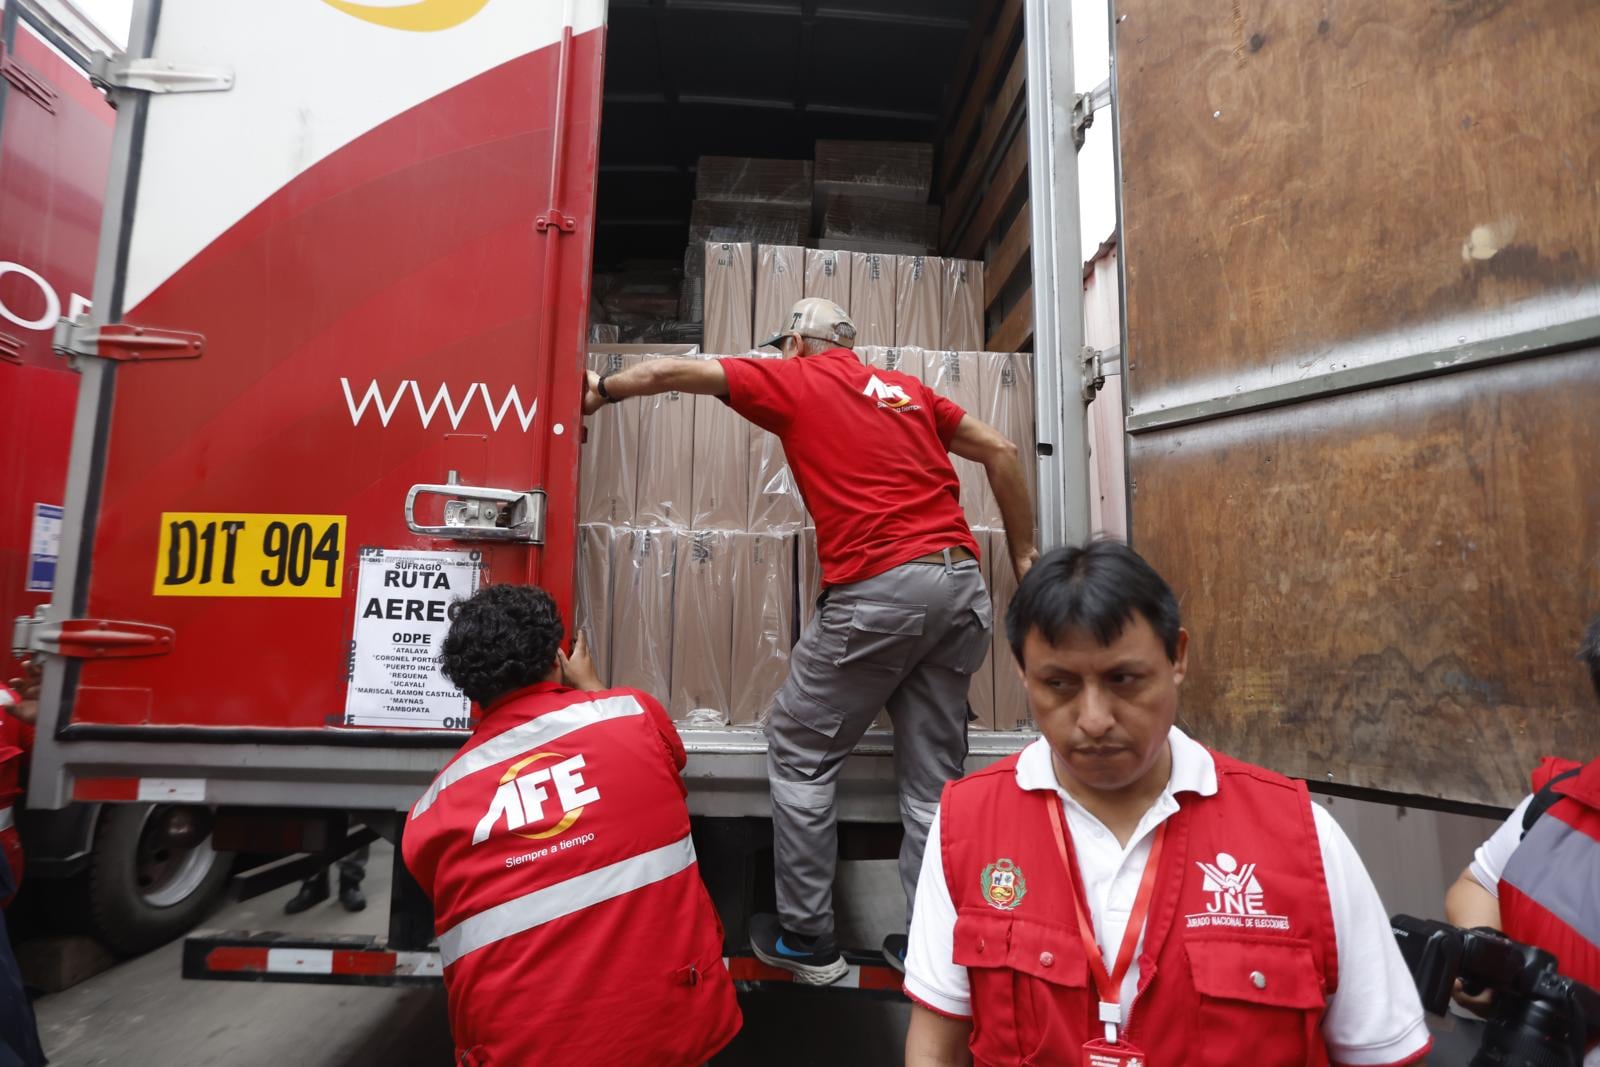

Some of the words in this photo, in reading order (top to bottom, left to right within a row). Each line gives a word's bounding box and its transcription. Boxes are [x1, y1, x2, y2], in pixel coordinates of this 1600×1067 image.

[260, 521, 340, 587] 904
[395, 562, 442, 571] SUFRAGIO
[384, 569, 451, 590] RUTA
[392, 632, 432, 644] ODPE
[396, 689, 424, 697] RAMON
[425, 690, 462, 698] CASTILLA
[472, 753, 601, 846] AFE
[505, 848, 548, 868] Siempre
[551, 845, 558, 854] a
[560, 832, 595, 850] tiempo
[1206, 891, 1268, 916] JNE
[1211, 916, 1244, 927] NACIONAL
[1245, 917, 1255, 928] DE
